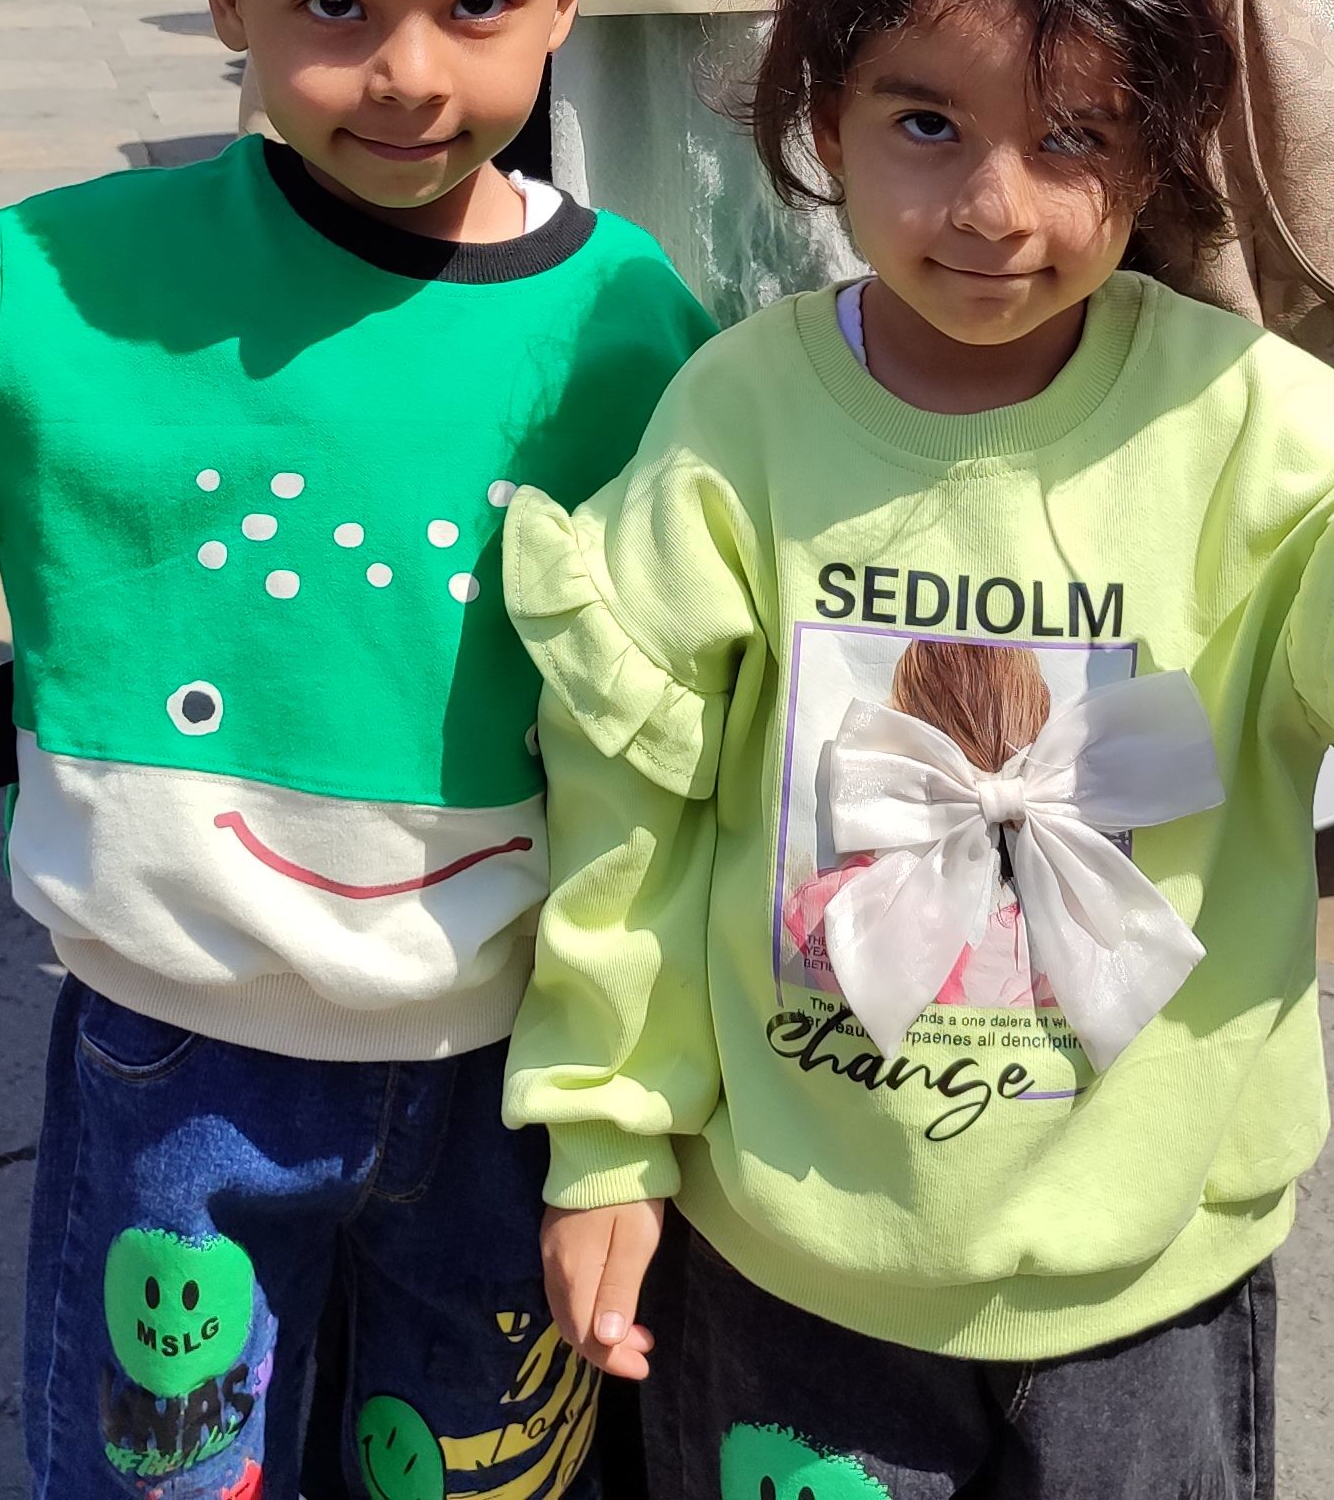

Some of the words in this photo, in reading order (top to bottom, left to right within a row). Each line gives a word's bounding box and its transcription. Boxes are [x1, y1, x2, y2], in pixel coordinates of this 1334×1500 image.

[814, 561, 1125, 640] SEDIOLM
[809, 997, 835, 1013] The
[948, 1016, 957, 1026] a
[961, 1016, 986, 1027] one
[978, 1031, 996, 1047] all
[136, 1315, 220, 1358] MSLG
